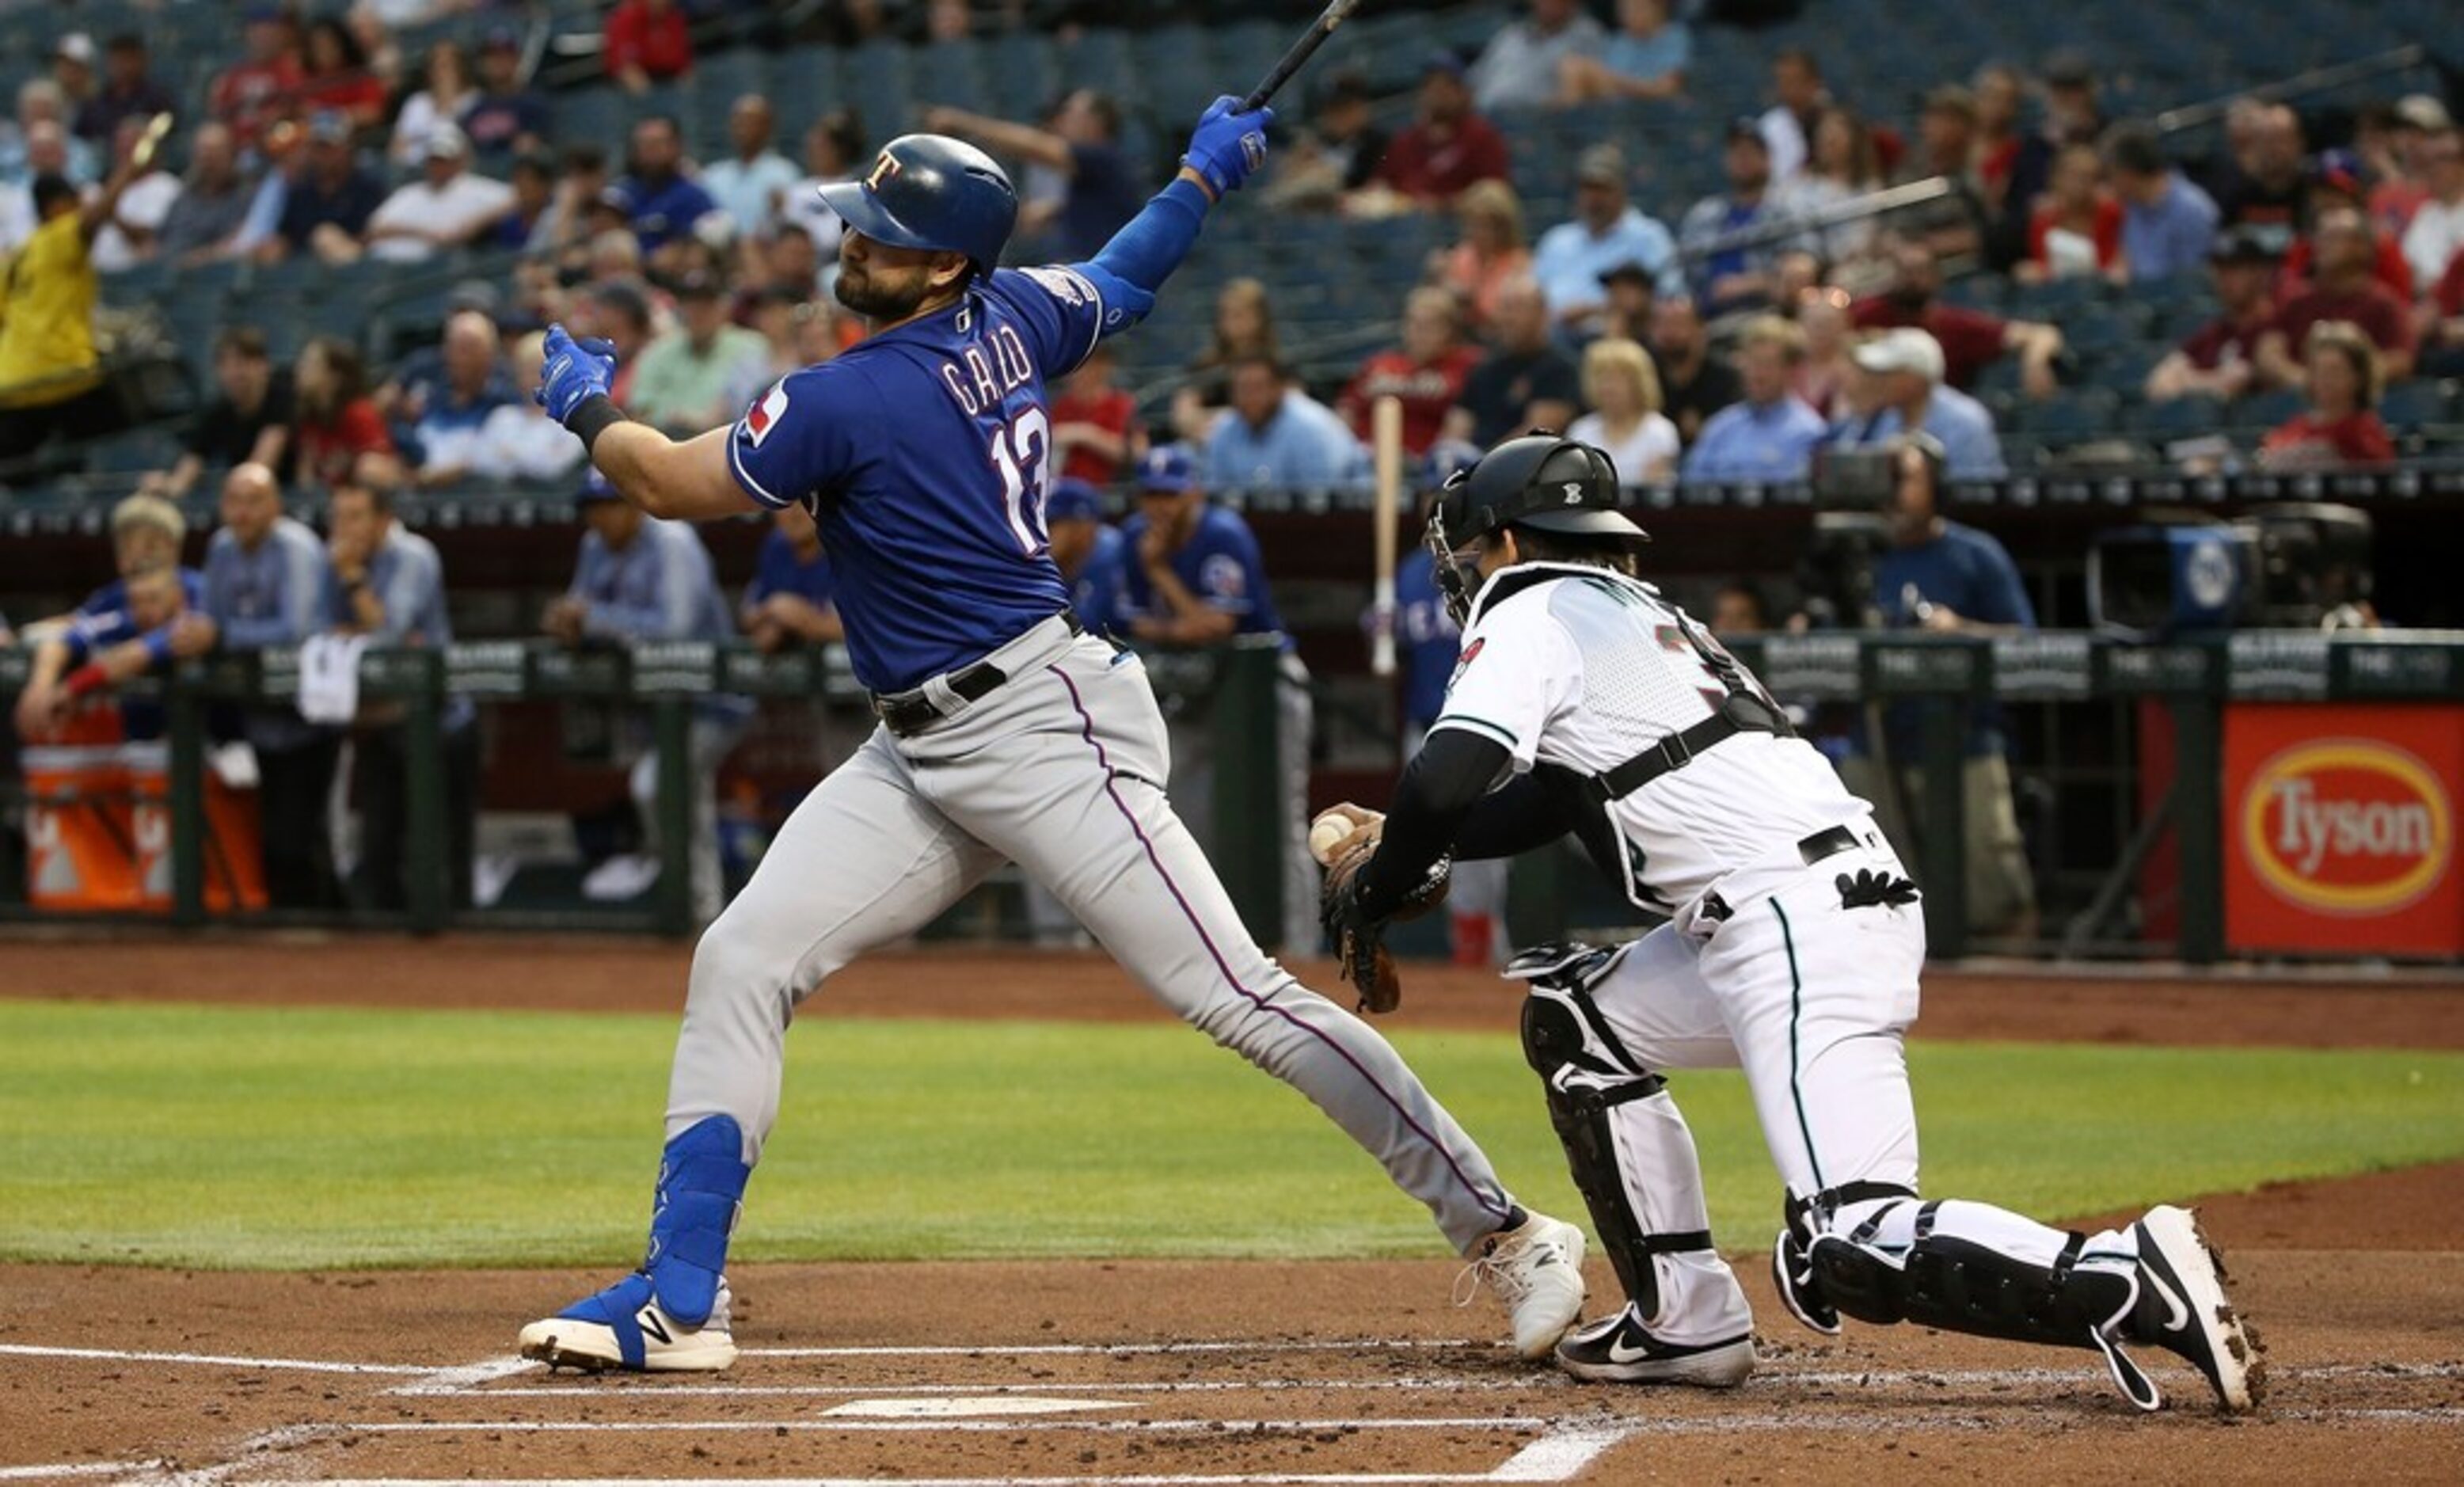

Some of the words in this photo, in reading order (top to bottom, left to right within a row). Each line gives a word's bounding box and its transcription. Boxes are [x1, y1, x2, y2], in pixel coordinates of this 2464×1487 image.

[865, 150, 902, 192] T
[989, 404, 1051, 556] 13
[2270, 776, 2432, 873] Tyson
